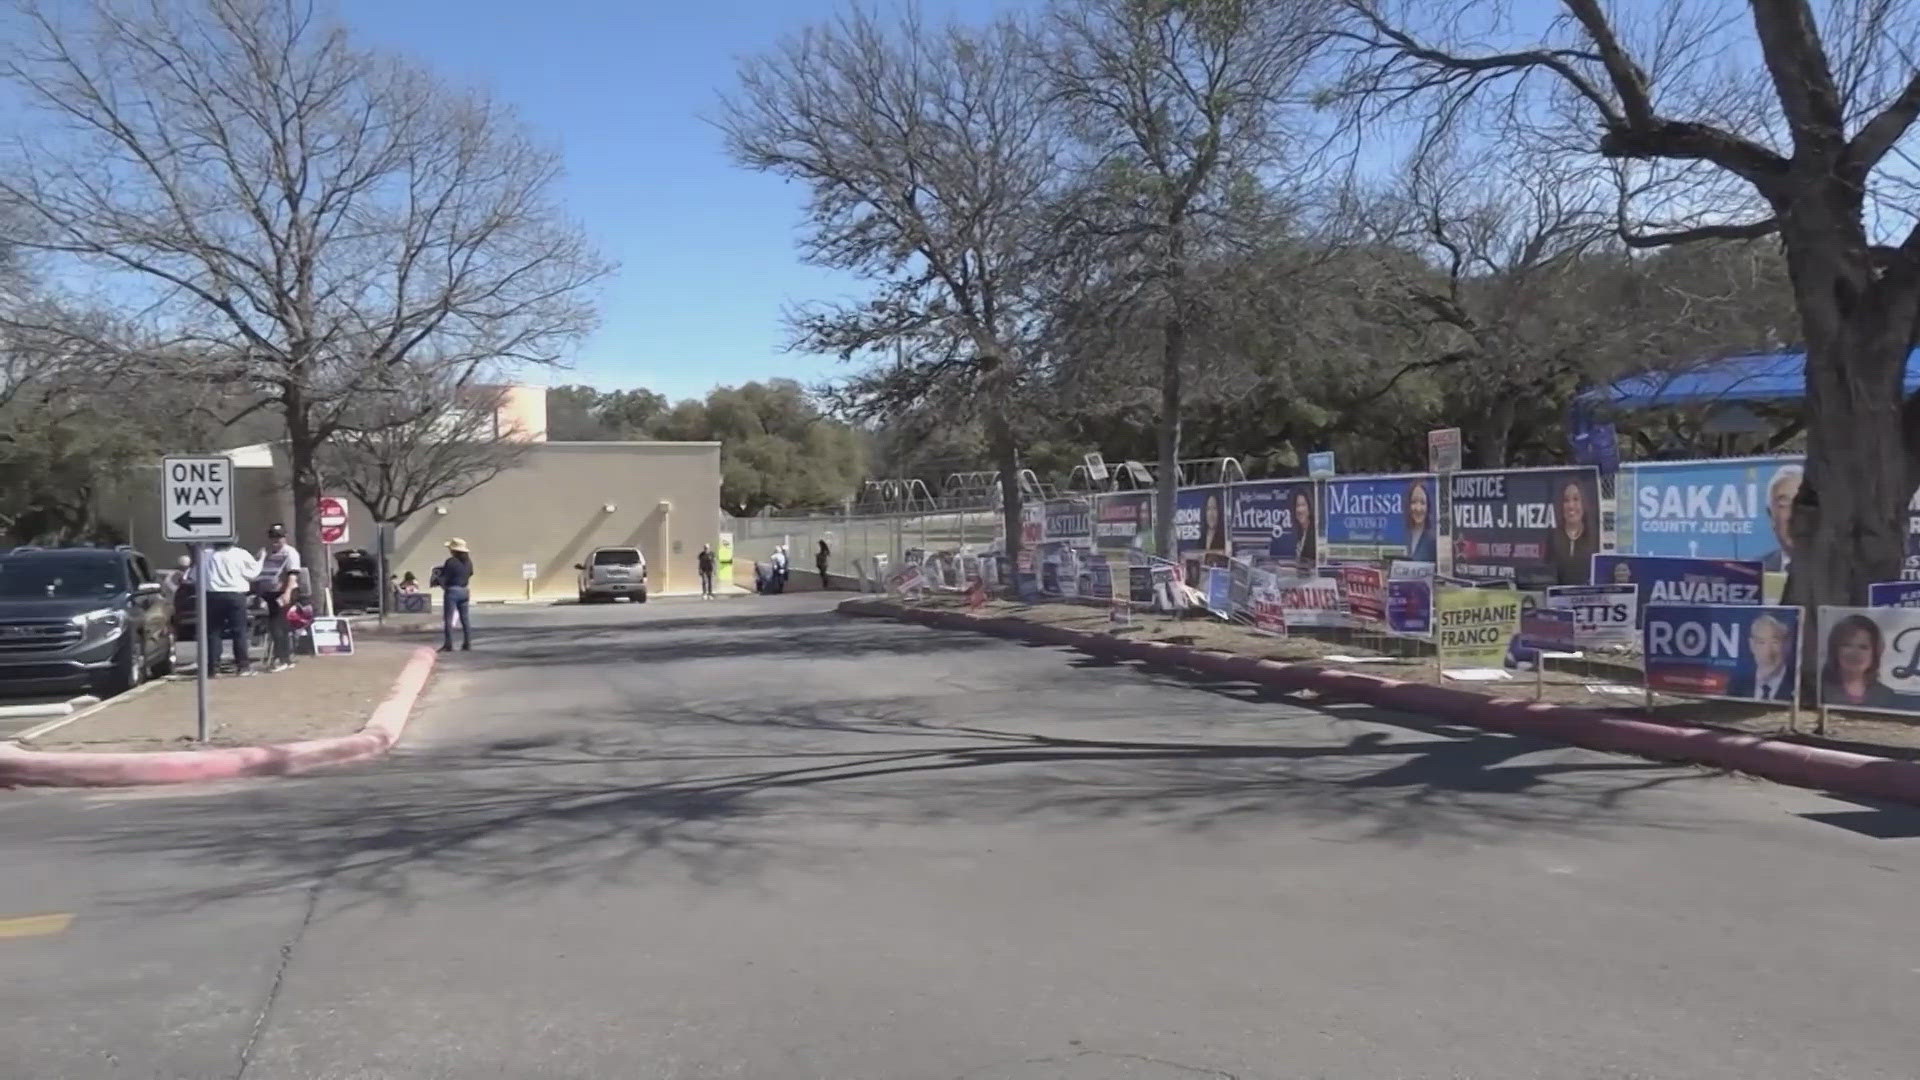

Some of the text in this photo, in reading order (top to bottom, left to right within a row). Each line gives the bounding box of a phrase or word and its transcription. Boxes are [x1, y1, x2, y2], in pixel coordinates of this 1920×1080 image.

[172, 463, 222, 482] ONE
[173, 487, 224, 506] WAY
[1453, 476, 1505, 498] JUSTICE
[1329, 484, 1403, 514] Marissa
[1639, 483, 1759, 519] SAKAI
[1232, 498, 1293, 538] Arteaga
[1454, 503, 1557, 529] VELIA J. MEZA
[1641, 520, 1754, 534] COUNTY JUDGE
[1513, 544, 1540, 558] JUSTICE
[1651, 580, 1760, 603] ALVAREZ
[1441, 604, 1518, 627] STEPHANIE
[1567, 604, 1627, 623] ETTS
[1441, 627, 1500, 647] FRANCO
[1649, 620, 1741, 659] RON
